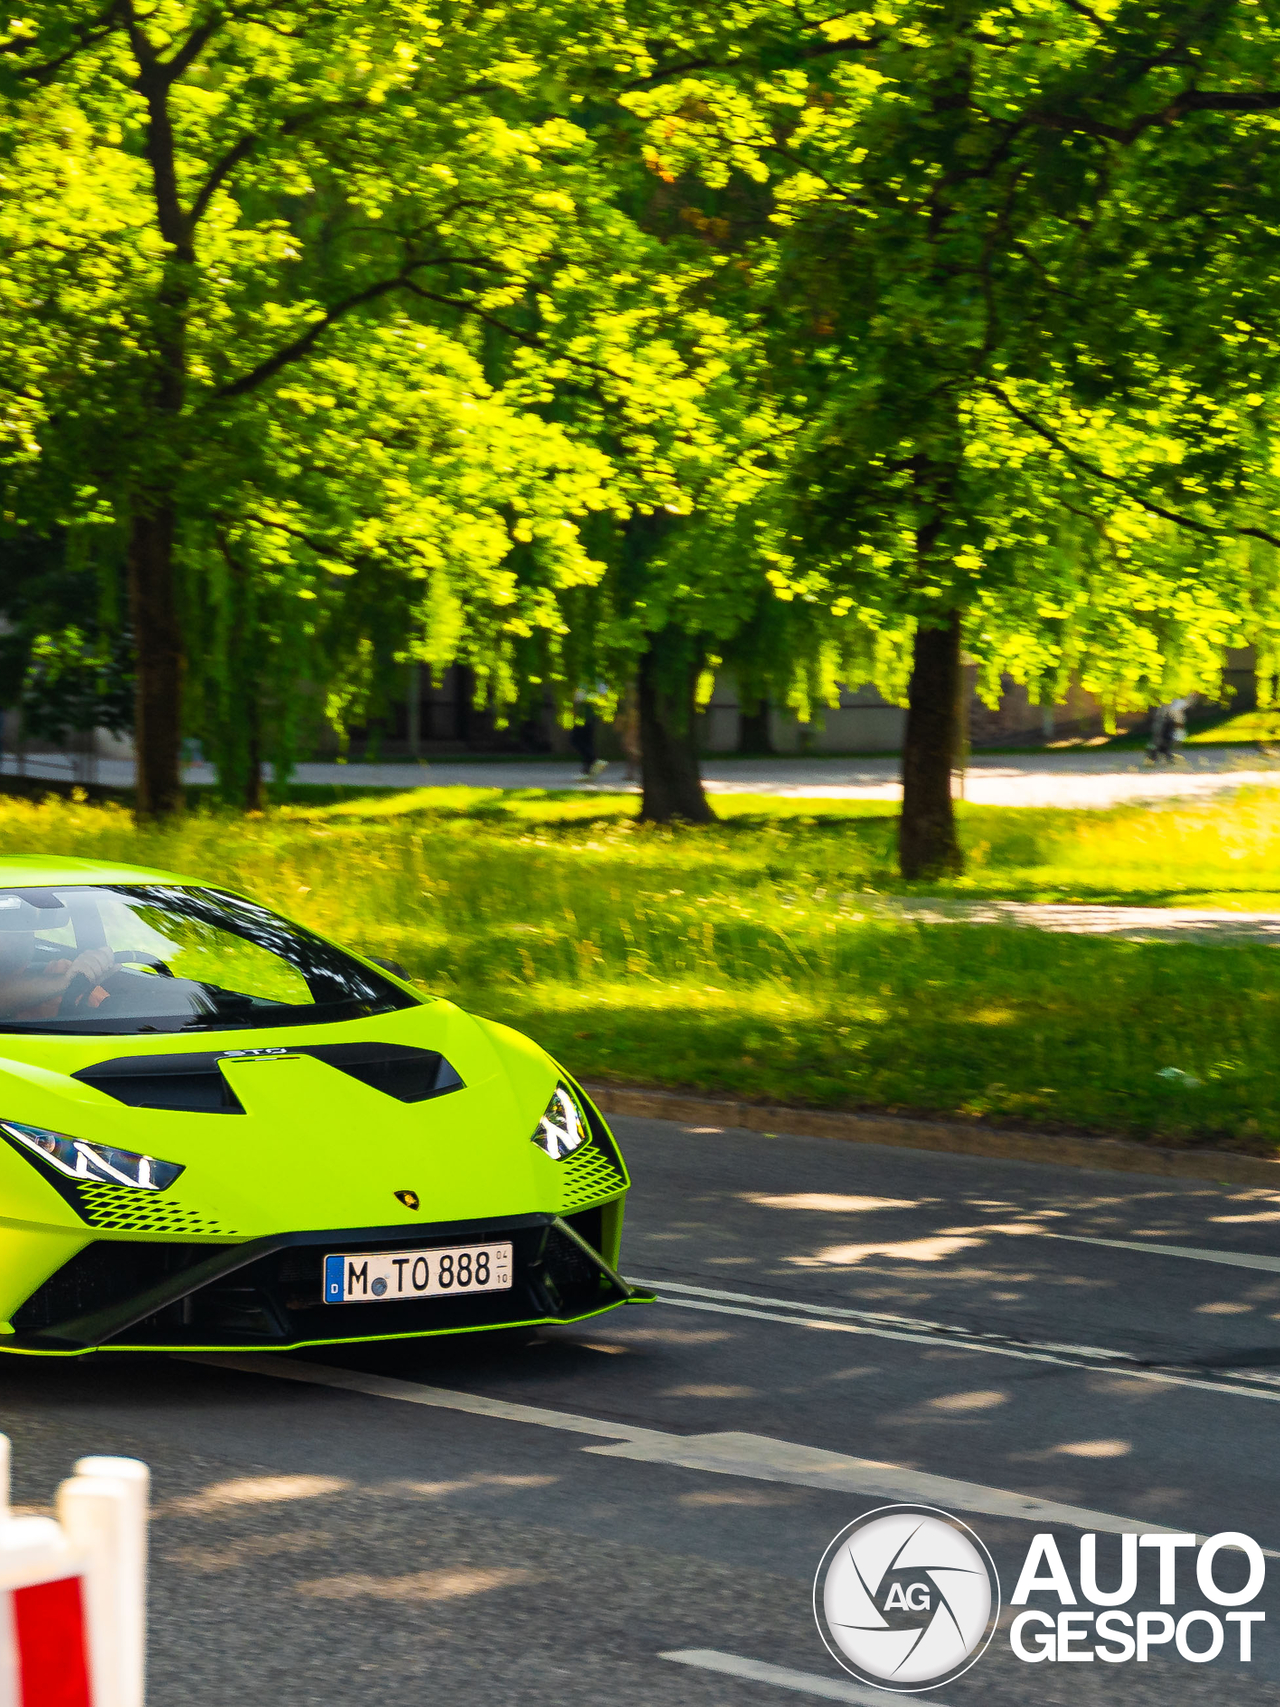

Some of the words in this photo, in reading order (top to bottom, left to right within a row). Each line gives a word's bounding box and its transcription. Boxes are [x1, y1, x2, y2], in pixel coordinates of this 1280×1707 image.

[496, 1250, 508, 1260] 04
[347, 1261, 368, 1295] M
[392, 1256, 429, 1292] TO
[438, 1251, 490, 1289] 888
[497, 1273, 508, 1283] 10
[330, 1283, 339, 1294] D
